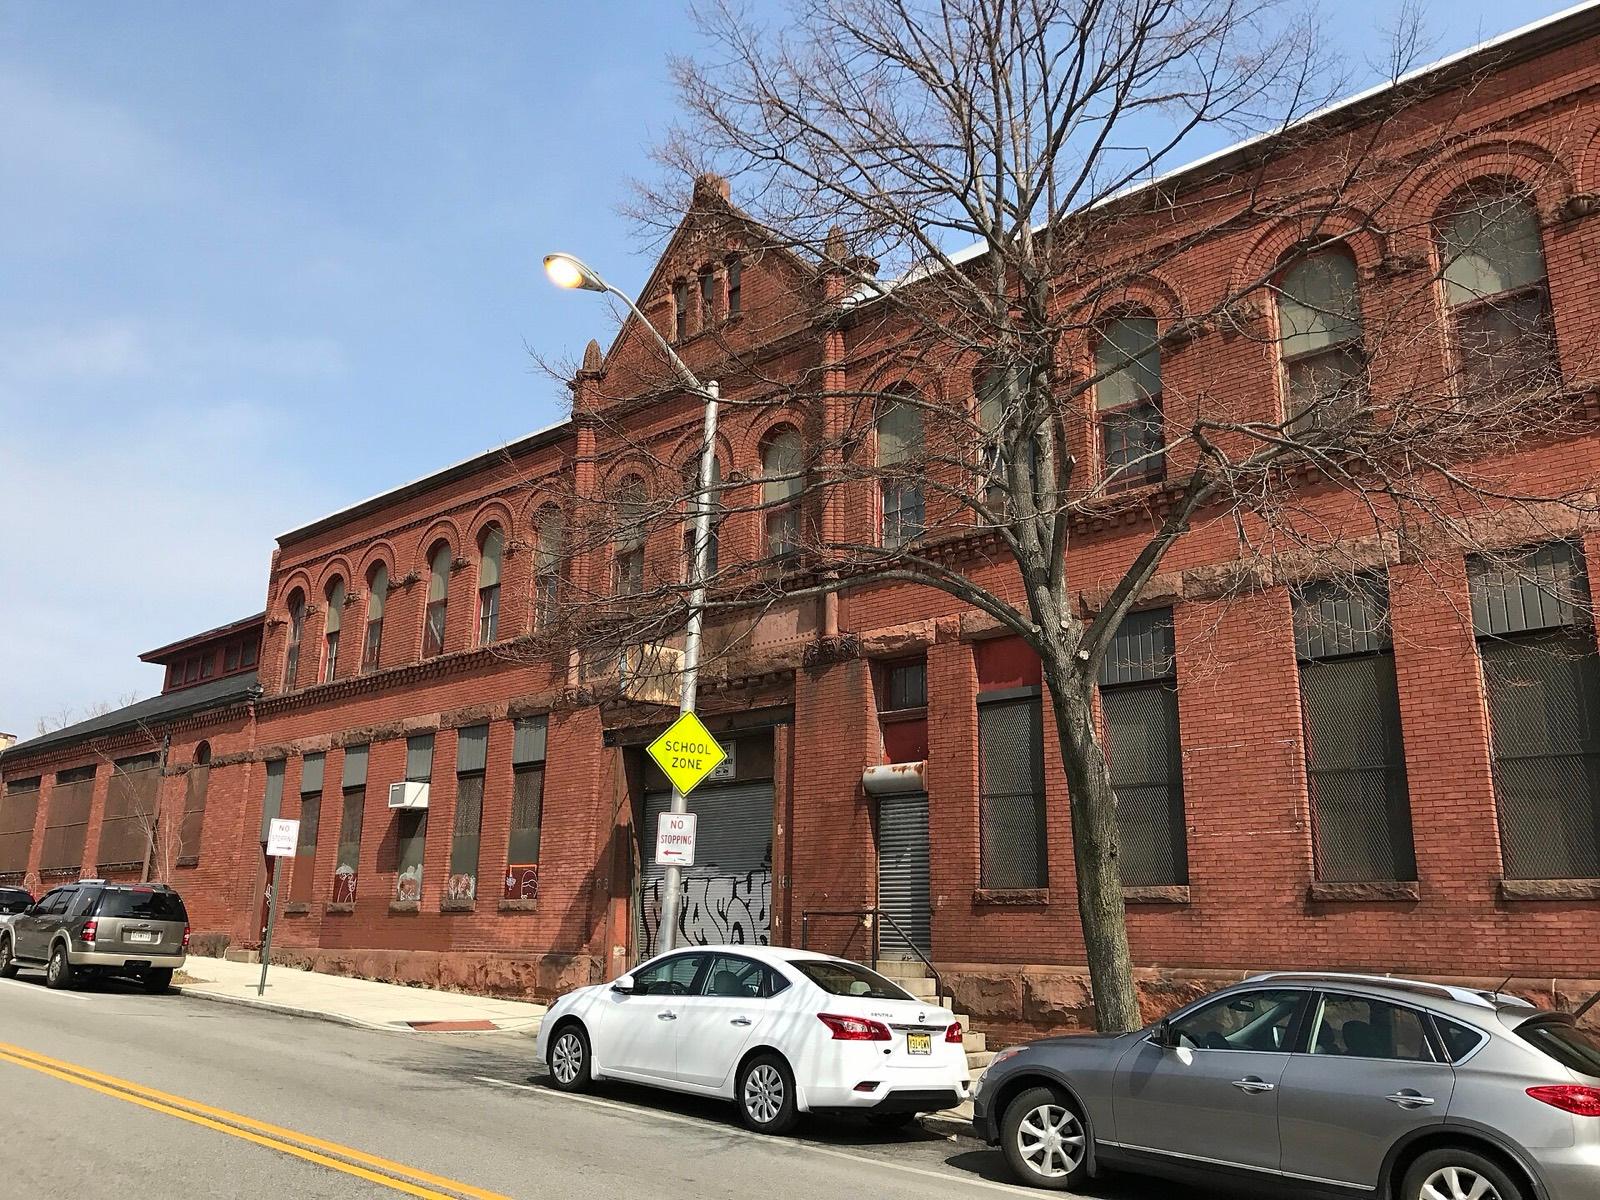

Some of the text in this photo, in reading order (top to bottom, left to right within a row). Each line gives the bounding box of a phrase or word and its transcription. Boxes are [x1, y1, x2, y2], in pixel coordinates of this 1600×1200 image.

[665, 740, 711, 755] SCHOOL
[671, 757, 702, 770] ZONE
[279, 824, 290, 832] NO
[670, 820, 684, 830] NO
[660, 834, 692, 845] STOPPING
